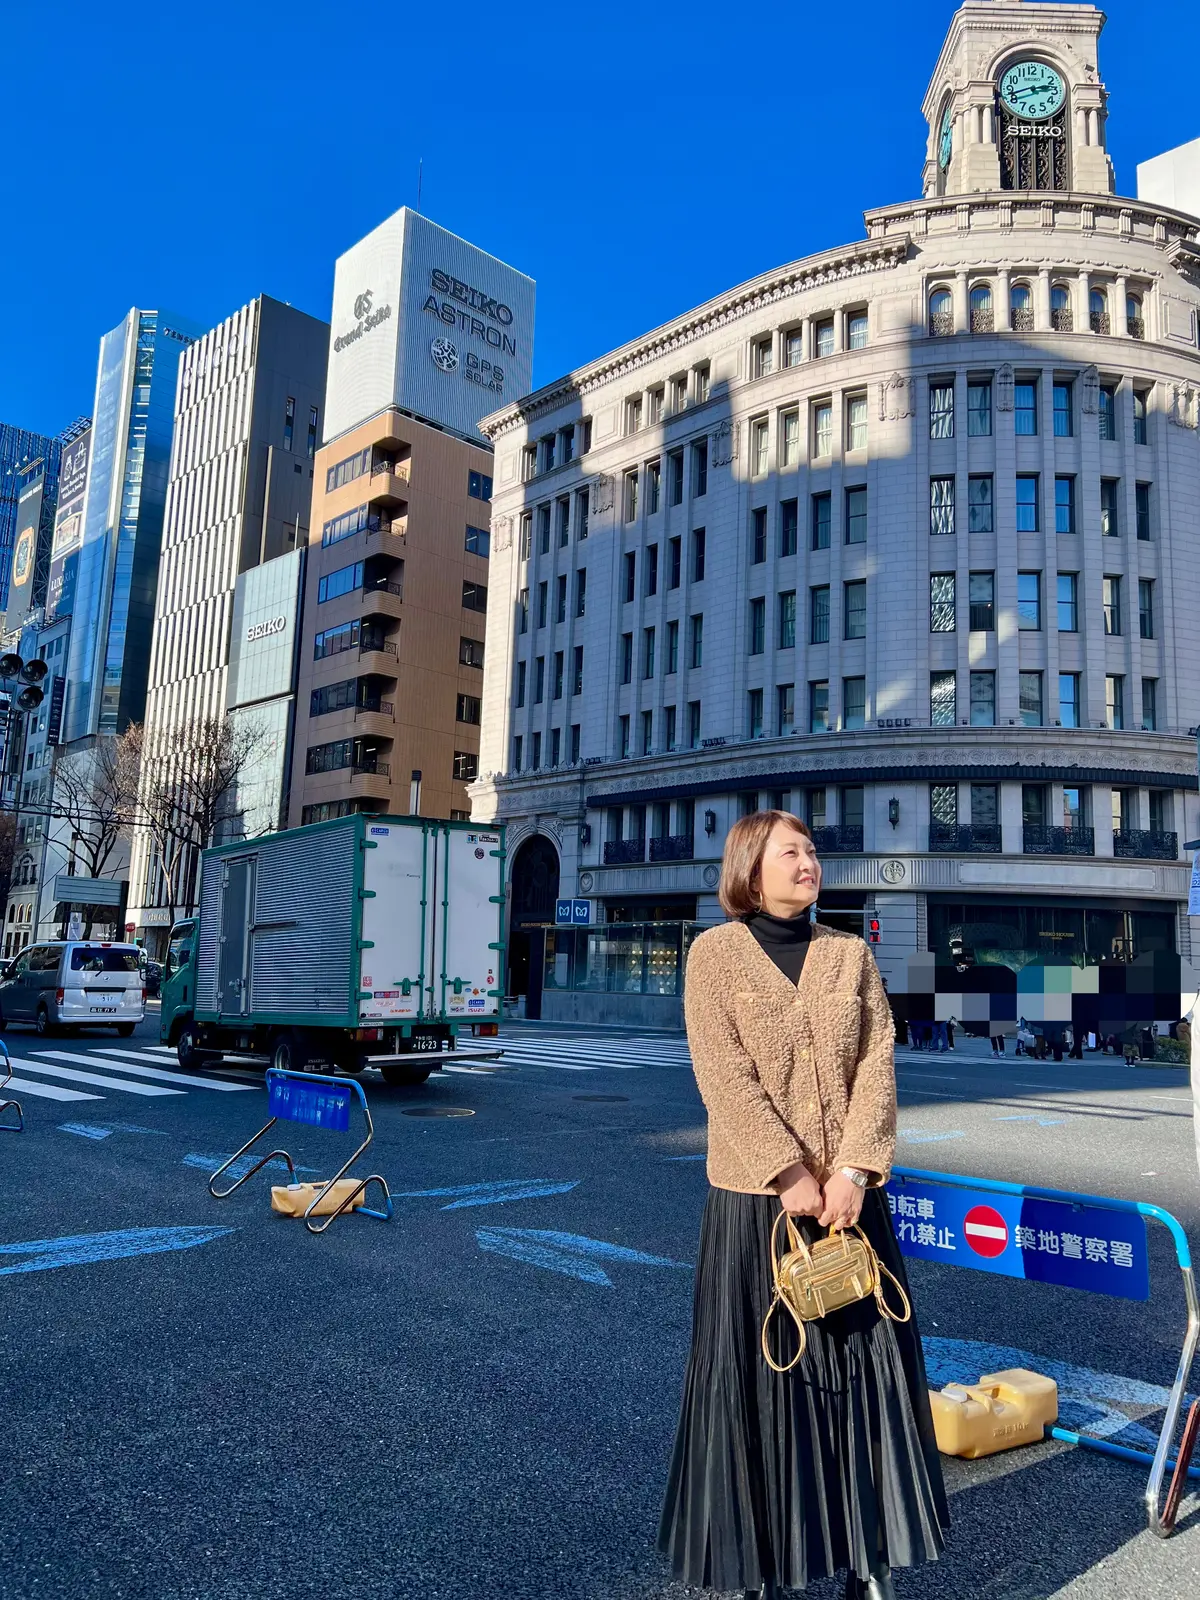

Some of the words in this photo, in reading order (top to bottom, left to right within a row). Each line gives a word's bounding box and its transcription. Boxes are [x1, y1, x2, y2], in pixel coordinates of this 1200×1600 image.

[1007, 125, 1062, 137] SEIKO
[431, 268, 514, 326] SEIKO
[422, 294, 517, 357] ASTRON
[466, 352, 504, 382] GPS
[464, 369, 503, 395] SOLAR
[246, 615, 287, 642] SEIKO
[417, 1040, 437, 1050] 16-23
[303, 1064, 330, 1072] ELF
[895, 1219, 957, 1250] れ禁止
[1014, 1224, 1134, 1268] 築地警察署
